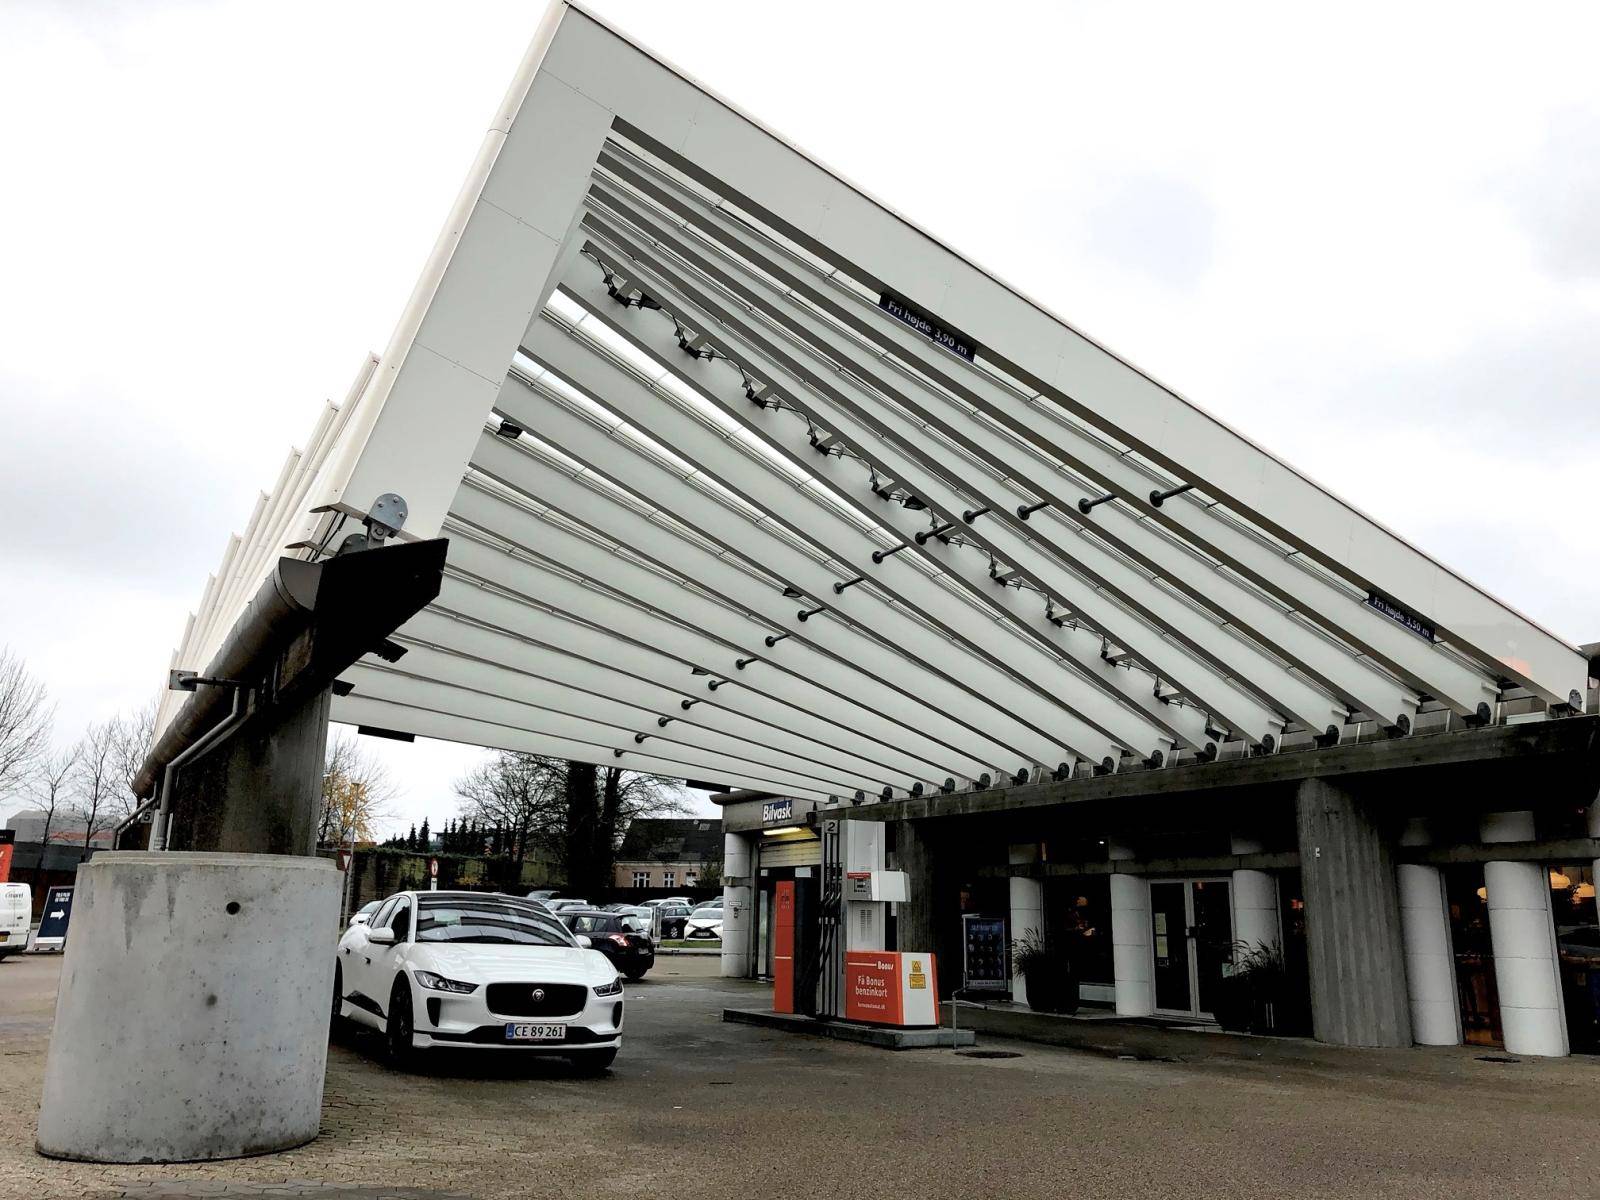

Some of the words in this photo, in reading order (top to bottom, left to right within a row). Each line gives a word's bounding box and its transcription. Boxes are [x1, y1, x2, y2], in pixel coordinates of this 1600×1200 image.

[888, 300, 903, 315] Fri
[904, 309, 932, 333] højde
[934, 329, 955, 347] 3,90
[957, 344, 968, 355] m
[1406, 616, 1421, 632] 3,50
[1422, 628, 1430, 637] m
[762, 801, 792, 821] Bilvask
[827, 821, 836, 832] 2
[857, 975, 866, 986] Få
[865, 976, 885, 987] Bonus
[855, 985, 888, 998] benzinkort
[514, 1026, 528, 1037] CE
[530, 1026, 544, 1037] 89
[546, 1026, 563, 1037] 261
